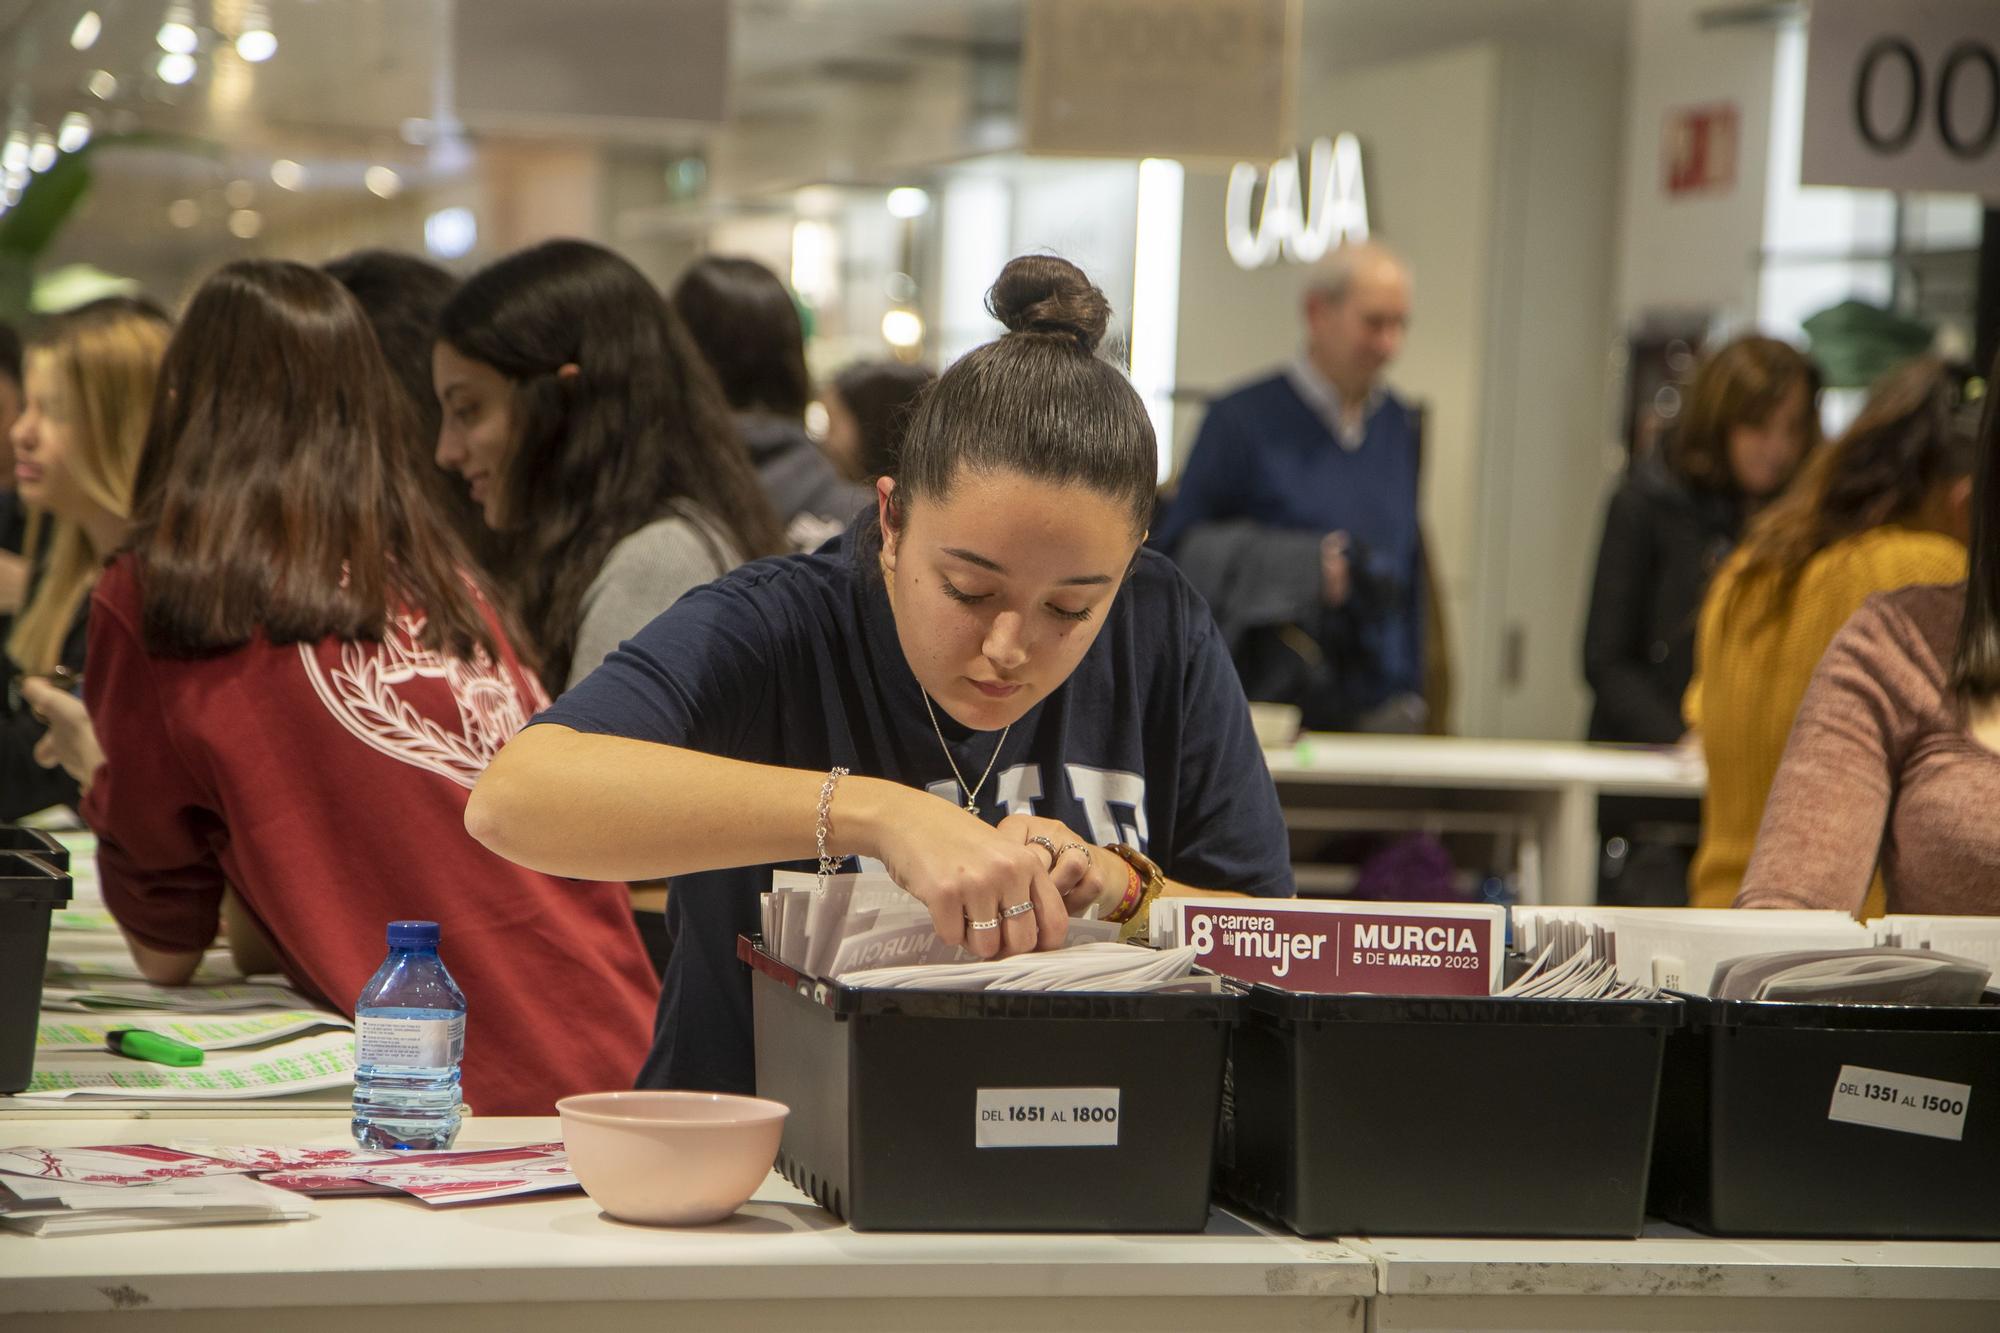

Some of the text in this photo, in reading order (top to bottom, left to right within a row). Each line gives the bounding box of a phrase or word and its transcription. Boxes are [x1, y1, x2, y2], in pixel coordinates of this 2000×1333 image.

[1219, 914, 1275, 931] carrera
[1354, 924, 1478, 953] MURCIA
[1234, 931, 1327, 977] mujer
[1353, 952, 1479, 969] 5 DE MARZO 2023
[1839, 1082, 1963, 1116] DEL 1351 AL 1500
[982, 1106, 1117, 1123] DEL 1651 AL 1800
